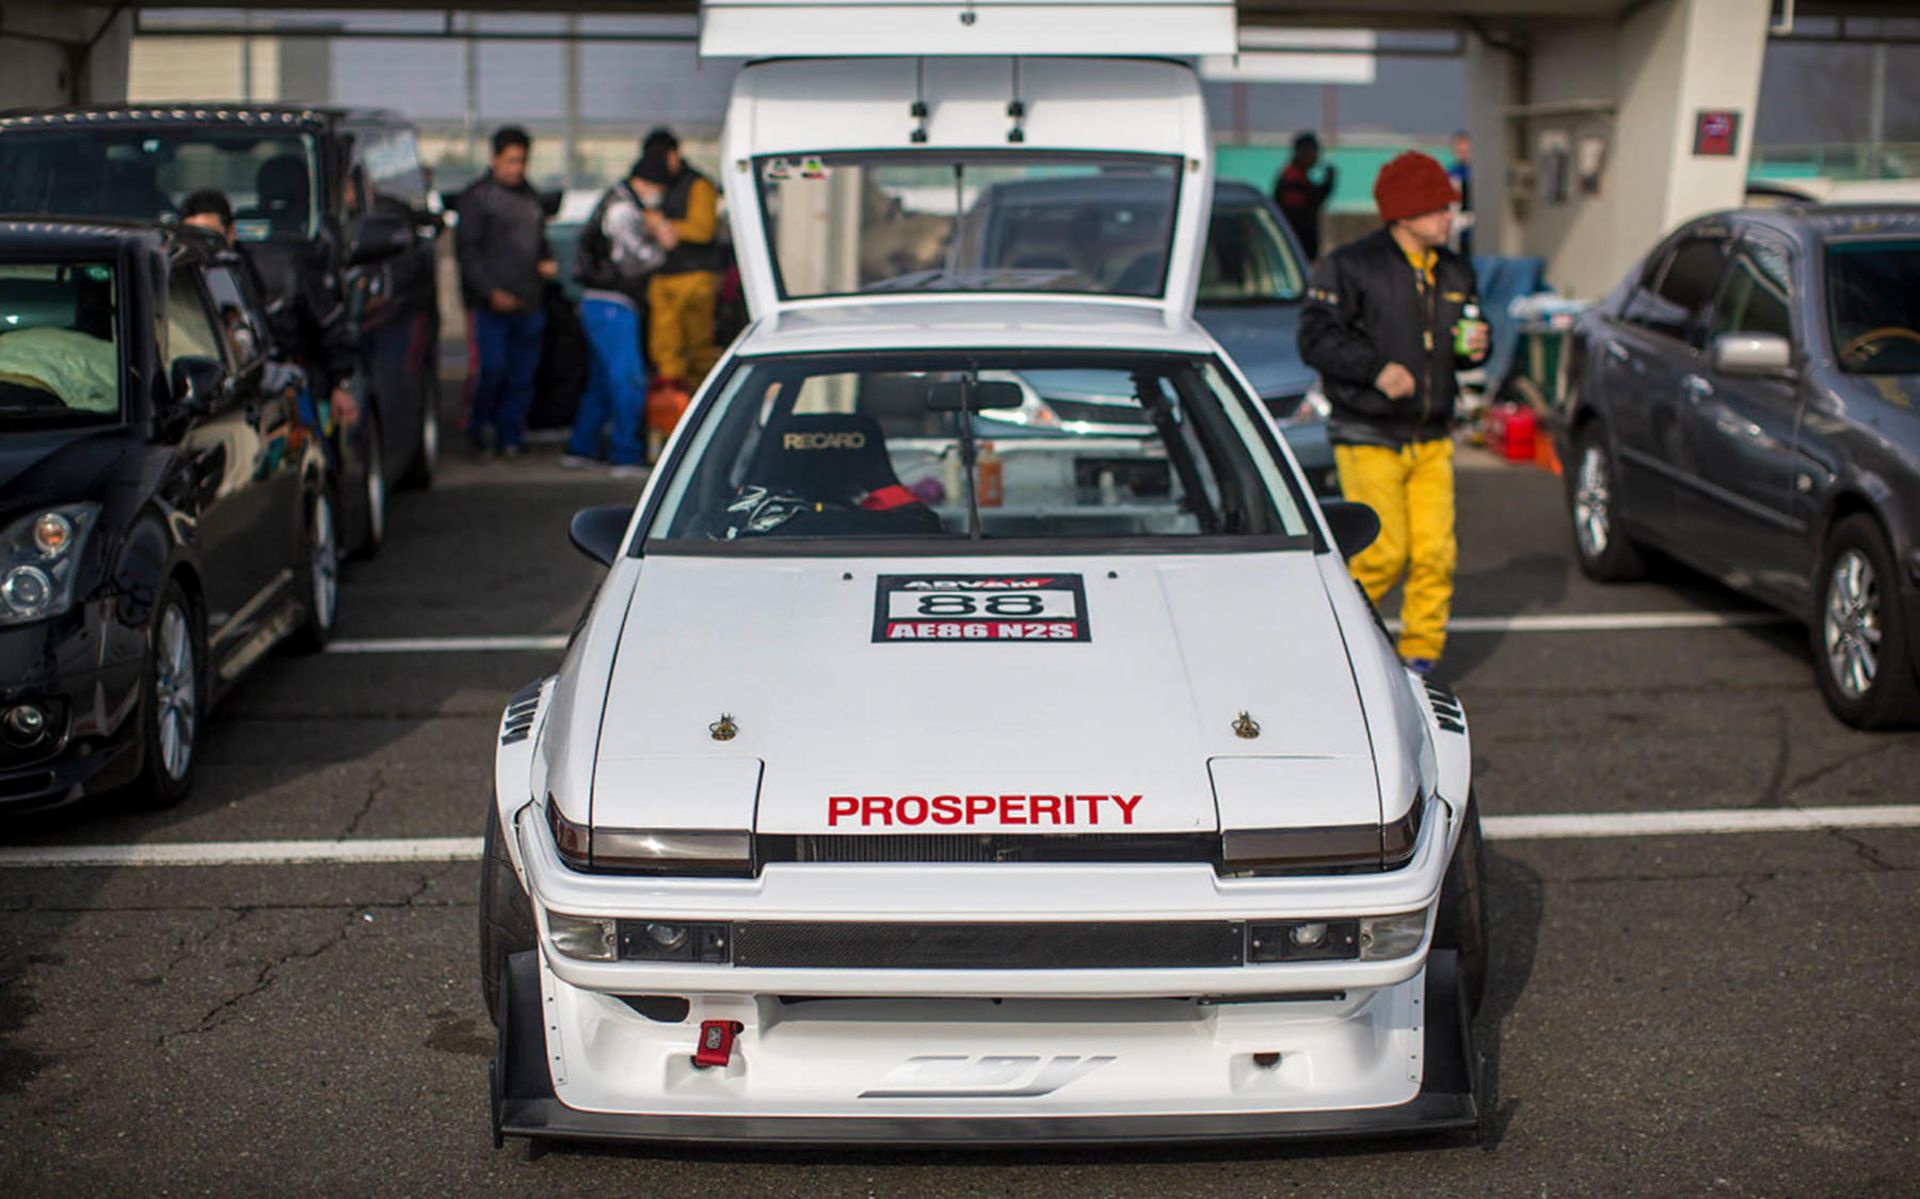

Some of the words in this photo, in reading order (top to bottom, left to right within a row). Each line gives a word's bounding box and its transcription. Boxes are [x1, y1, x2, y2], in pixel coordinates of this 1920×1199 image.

[783, 432, 866, 449] RECARO
[917, 594, 1045, 616] 88
[889, 623, 989, 640] AE86
[997, 623, 1075, 639] N2S
[828, 795, 1144, 826] PROSPERITY
